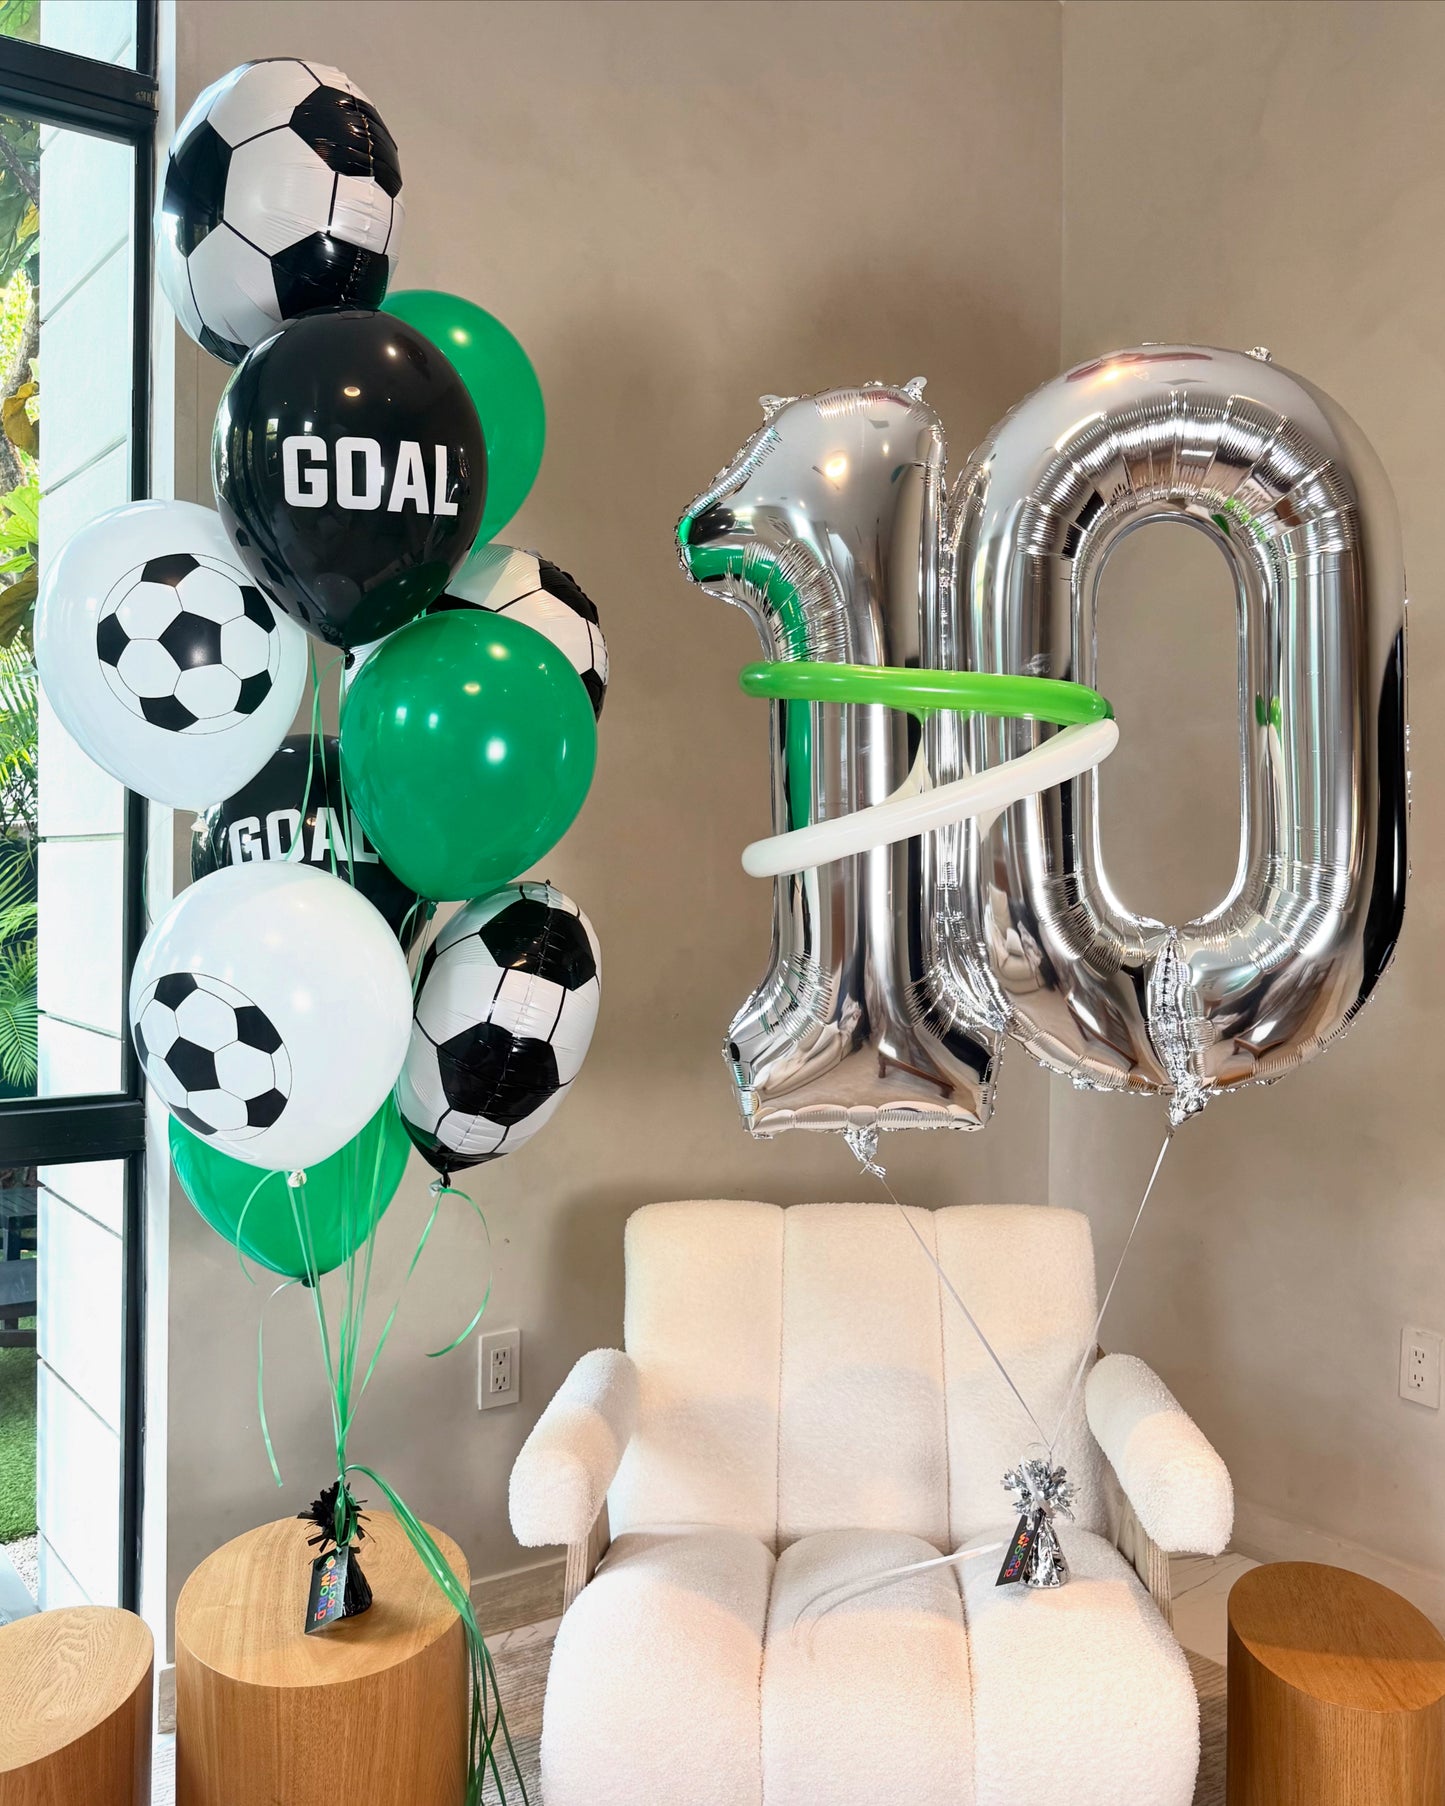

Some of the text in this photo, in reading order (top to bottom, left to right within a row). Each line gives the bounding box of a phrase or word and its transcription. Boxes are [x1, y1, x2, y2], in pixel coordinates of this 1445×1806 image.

[282, 435, 459, 516] GOAL
[674, 343, 1410, 1140] 10
[228, 806, 380, 866] GOAL
[317, 1571, 331, 1620] WORLD
